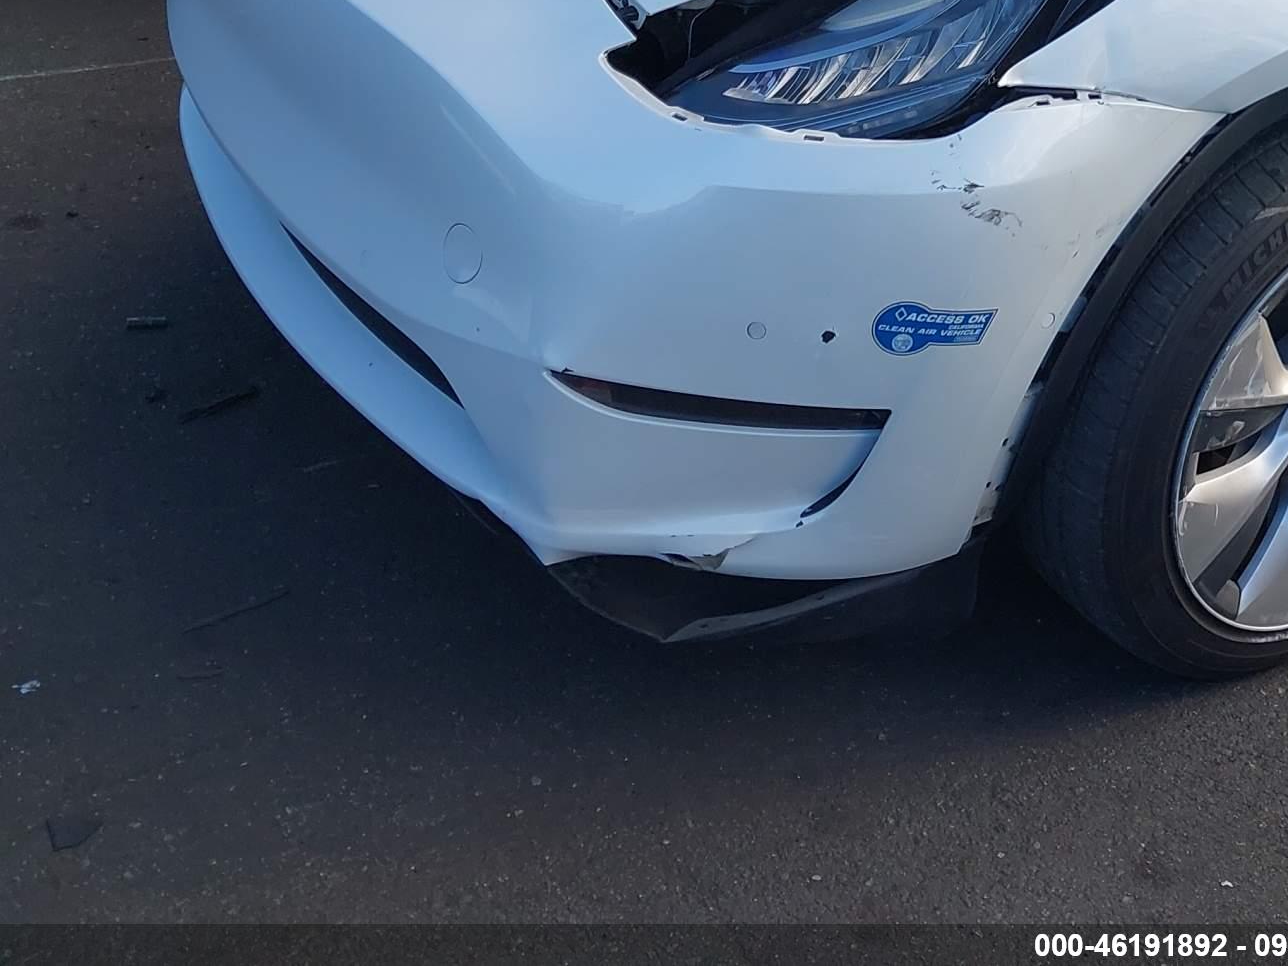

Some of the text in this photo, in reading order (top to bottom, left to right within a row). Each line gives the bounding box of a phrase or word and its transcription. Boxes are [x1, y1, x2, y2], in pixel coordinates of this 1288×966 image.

[905, 312, 990, 324] ACCESS OK
[878, 324, 983, 337] CLEAN AIR VEHICLE
